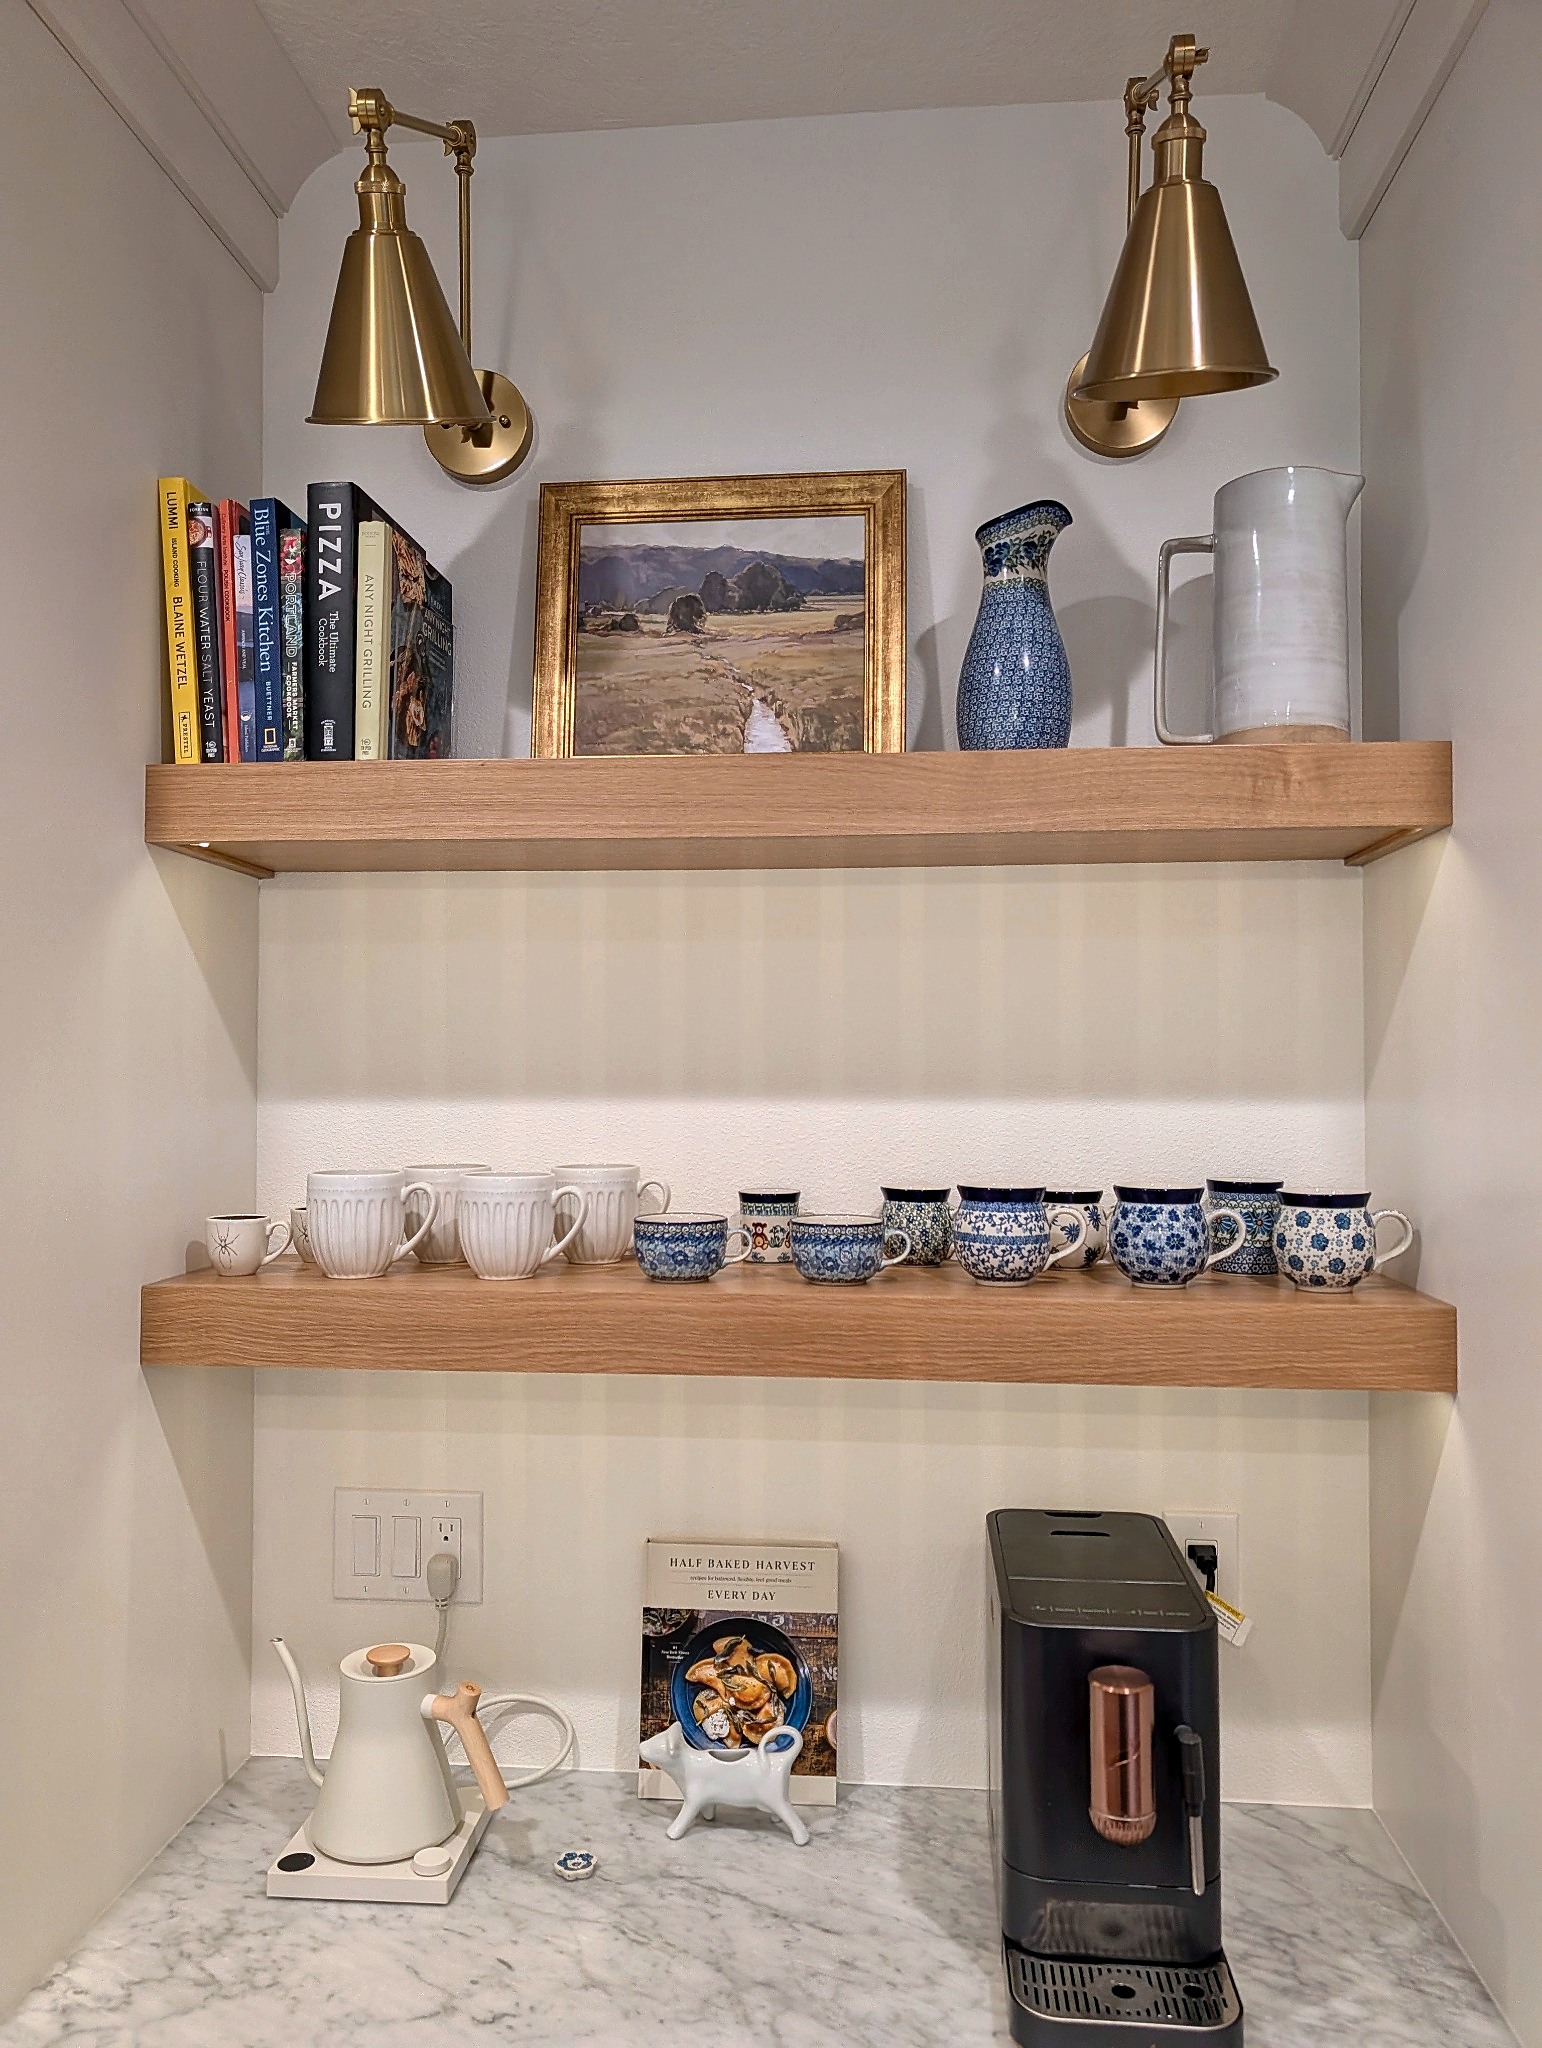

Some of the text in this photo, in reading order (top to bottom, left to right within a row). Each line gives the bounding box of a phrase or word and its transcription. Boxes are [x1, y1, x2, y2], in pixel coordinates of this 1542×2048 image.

[318, 502, 342, 601] PIZZA
[166, 491, 188, 689] LUMMI ISLAND COOKING BLAINE WETZEL
[196, 561, 208, 602] FLOUR
[253, 508, 274, 672] Blue Zones Kitchen
[199, 606, 211, 650] WATER
[285, 572, 298, 658] PORTLAND
[318, 617, 329, 667] Cookbook
[328, 611, 340, 673] The Ultimate
[362, 574, 374, 709] ANY NIGHT GRILLING
[201, 654, 213, 684] SALT
[203, 688, 215, 728] YEAST
[265, 681, 273, 721] BUETTNER
[291, 699, 299, 730] MARKET
[670, 1557, 816, 1571] HALF BAKED HARVEST
[708, 1589, 776, 1601] EVERY DAY
